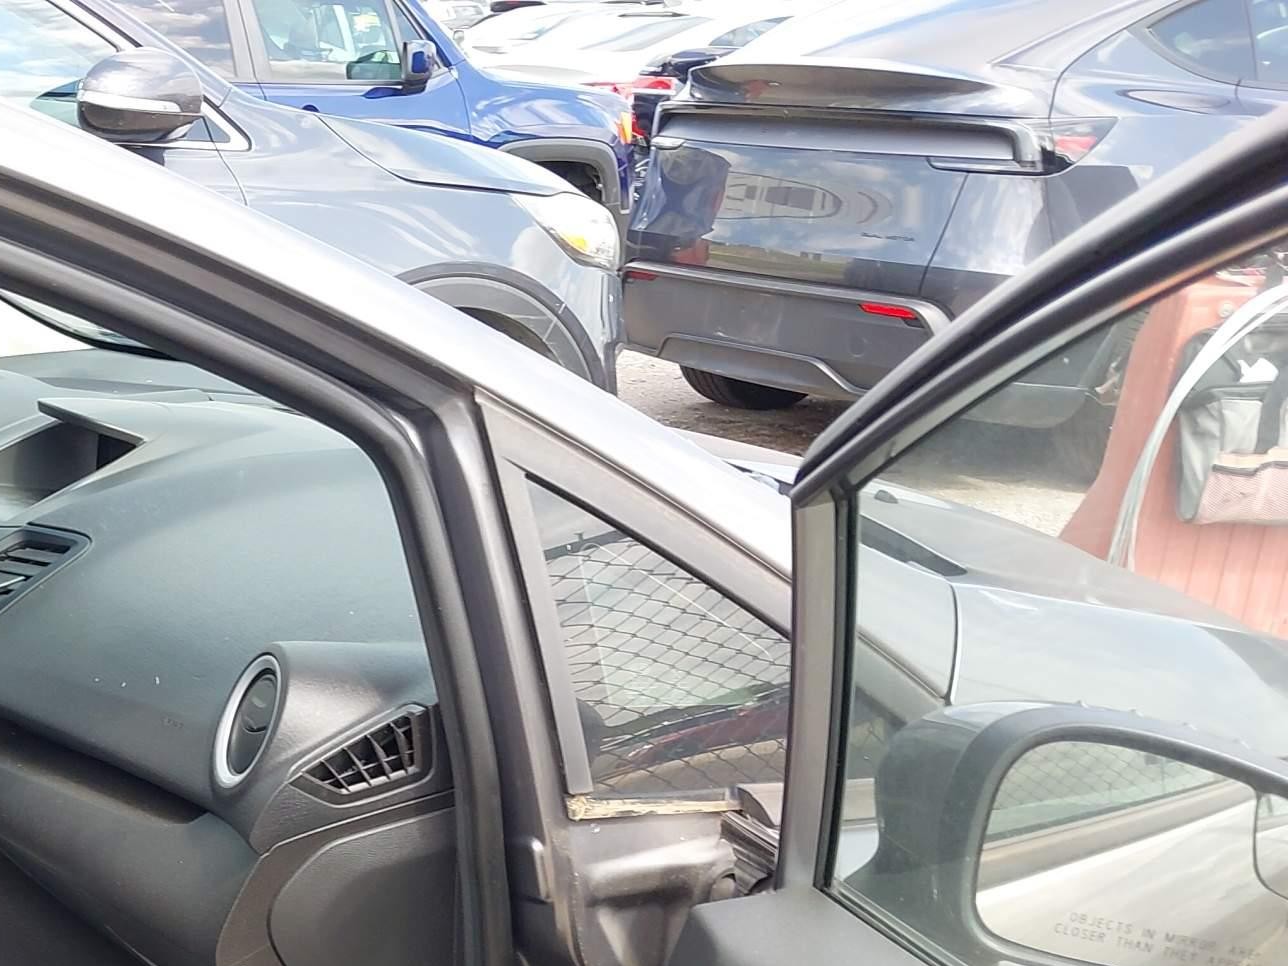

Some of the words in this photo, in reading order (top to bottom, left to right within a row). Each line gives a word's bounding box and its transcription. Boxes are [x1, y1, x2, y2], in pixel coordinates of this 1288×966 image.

[1054, 923, 1106, 943] CLOSER
[1116, 936, 1153, 953] THAN
[1069, 912, 1133, 934] OBJECTS
[1141, 928, 1156, 939] IN
